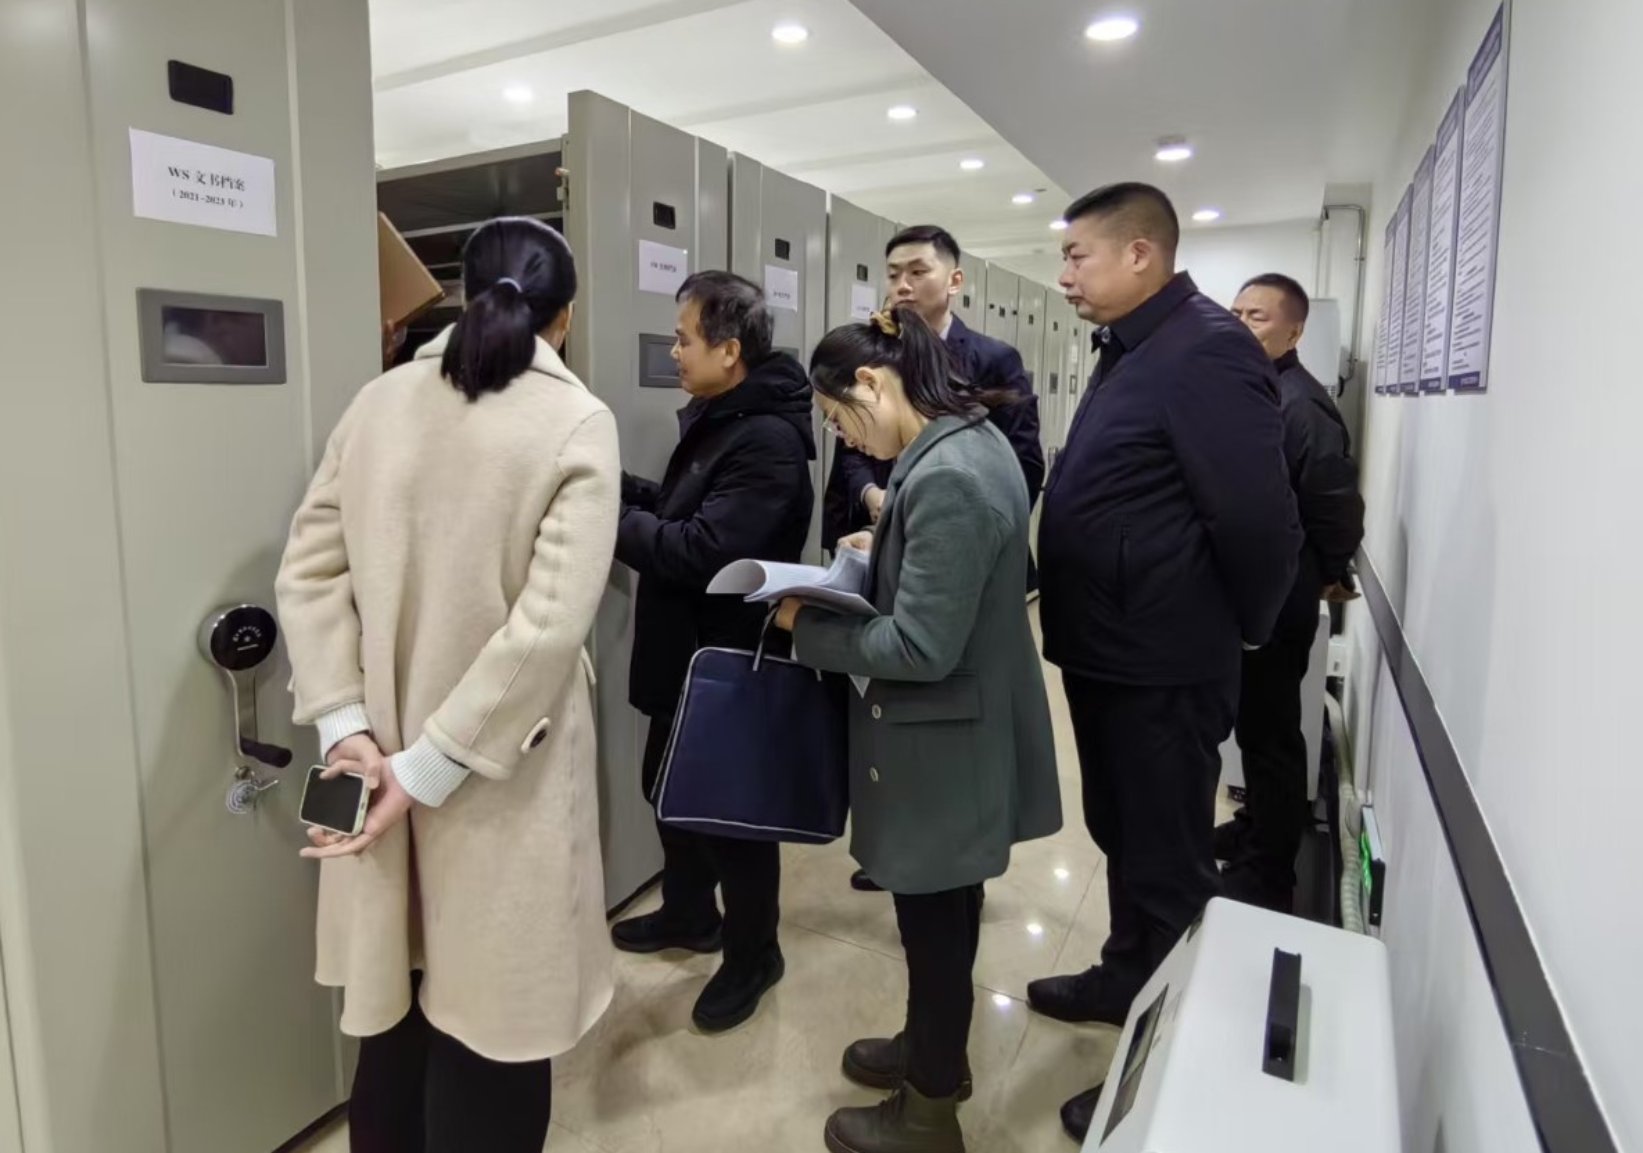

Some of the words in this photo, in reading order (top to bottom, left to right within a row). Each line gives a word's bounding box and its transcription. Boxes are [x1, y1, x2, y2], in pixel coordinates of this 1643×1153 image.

[168, 166, 190, 180] WS
[196, 170, 245, 192] 文书档案
